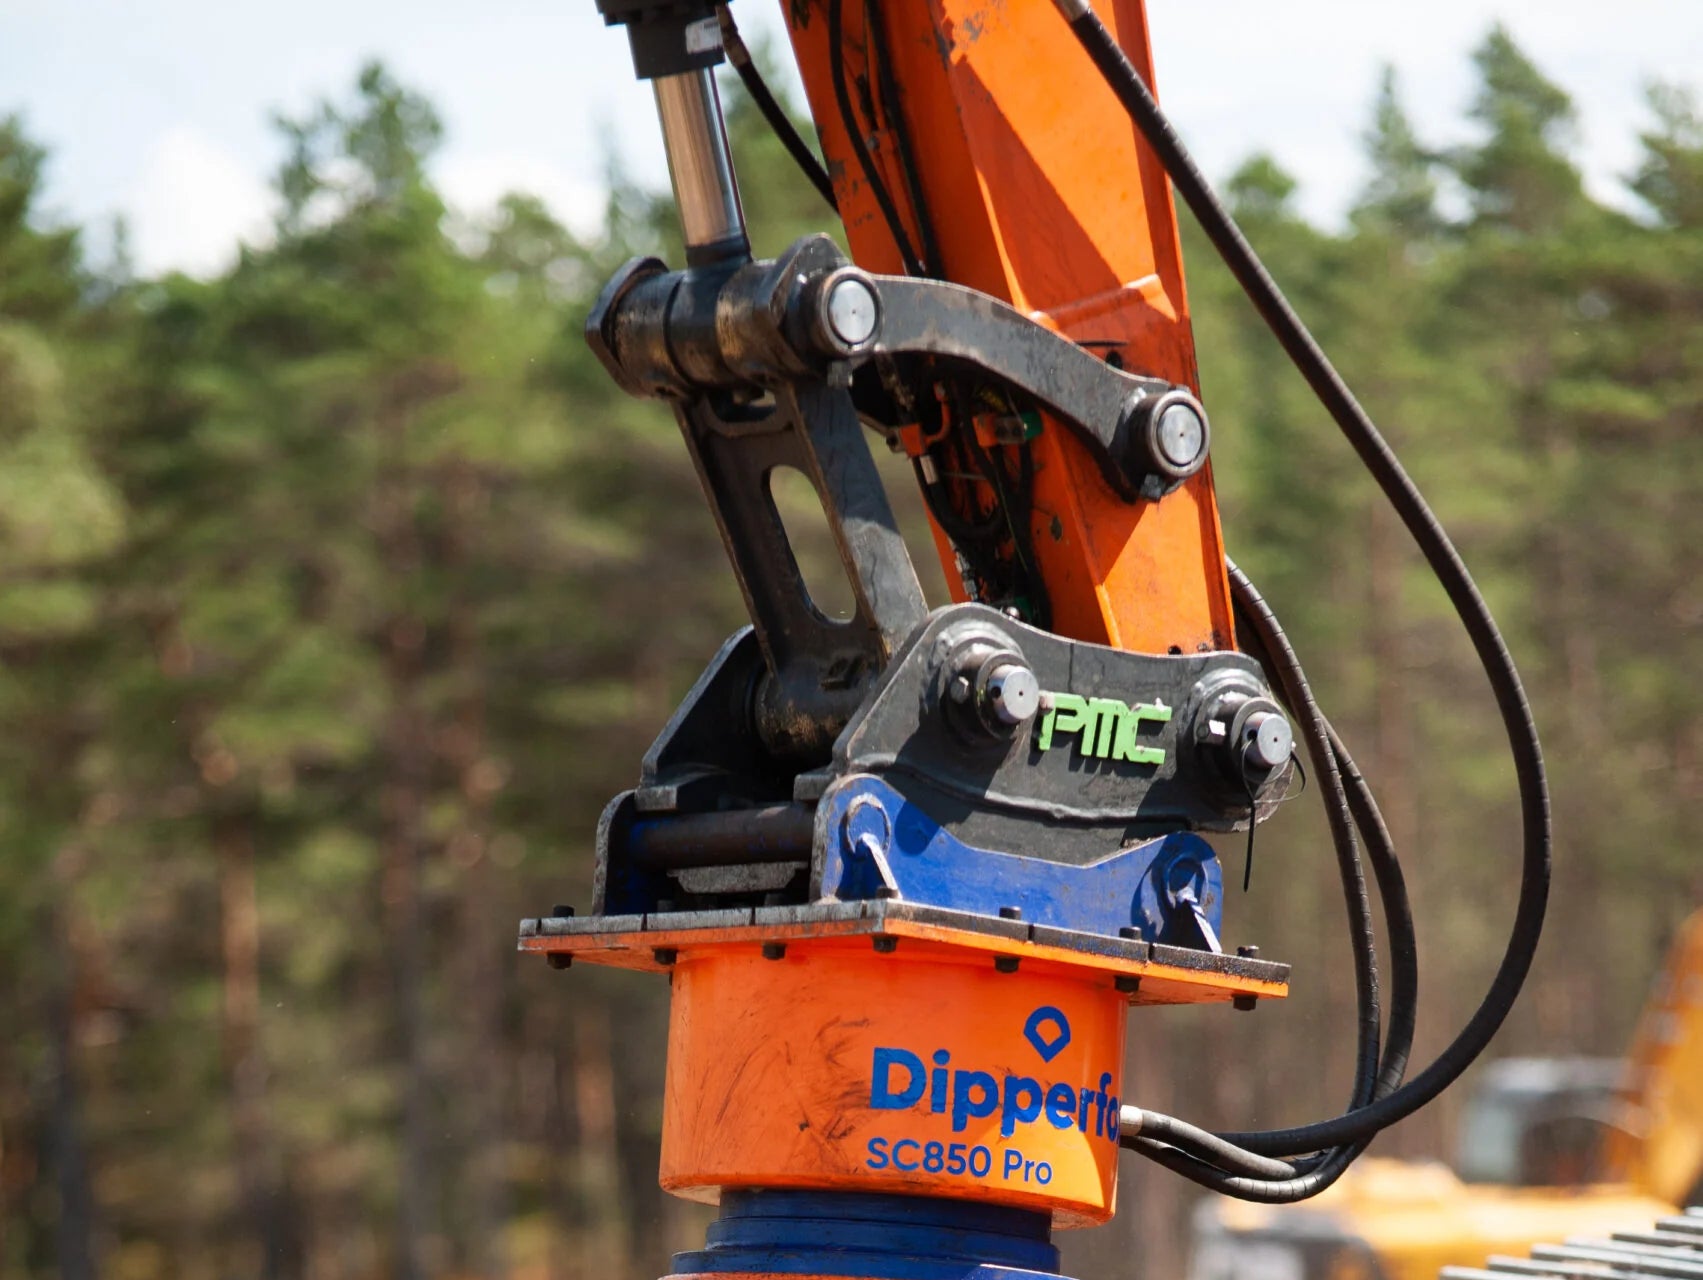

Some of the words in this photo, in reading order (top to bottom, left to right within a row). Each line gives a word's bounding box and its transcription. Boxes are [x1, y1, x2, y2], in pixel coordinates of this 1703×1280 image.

[1039, 692, 1172, 765] PMC
[870, 1046, 1120, 1143] Dipperfo
[866, 1137, 992, 1178] SC850
[1003, 1149, 1053, 1185] Pro
